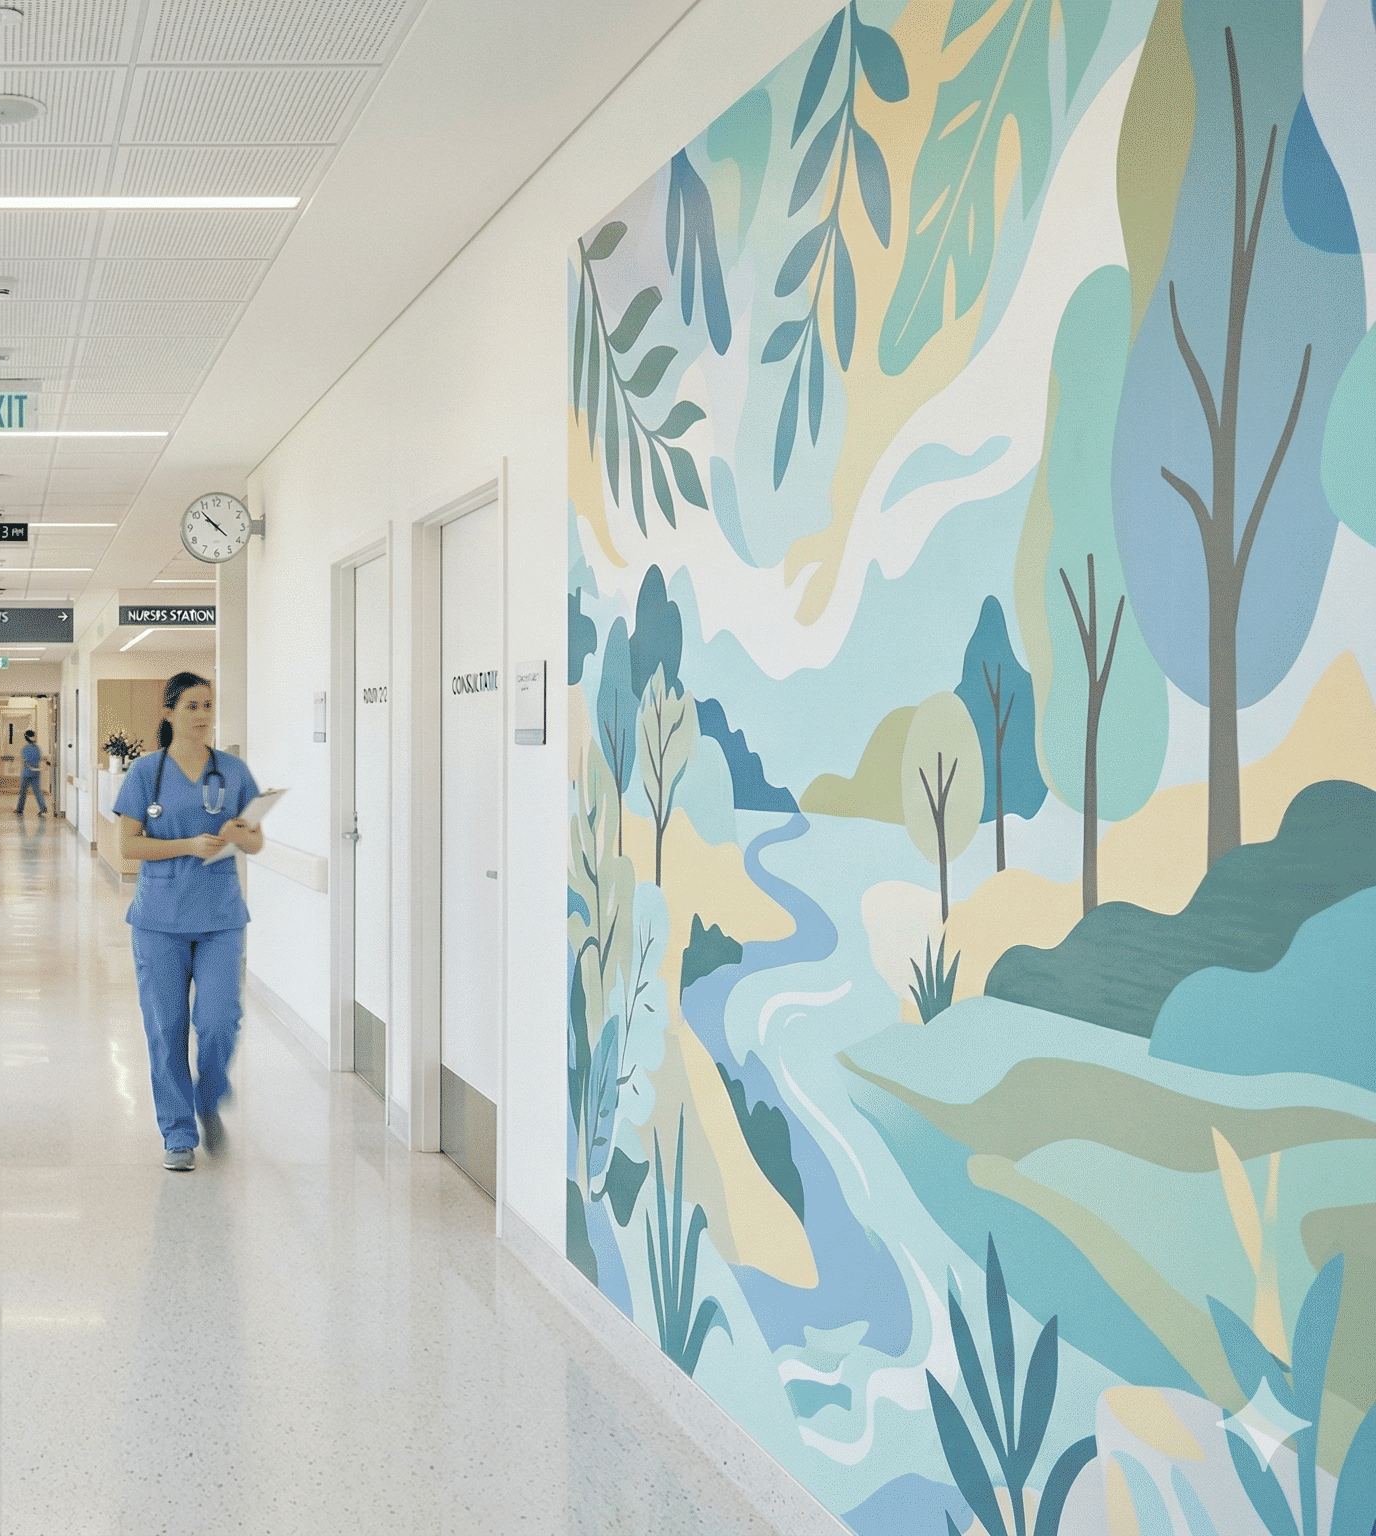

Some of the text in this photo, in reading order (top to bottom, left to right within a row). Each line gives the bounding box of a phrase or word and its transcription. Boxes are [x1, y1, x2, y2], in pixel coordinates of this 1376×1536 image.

[187, 523, 194, 532] 9
[240, 523, 246, 532] 3
[191, 536, 198, 544] 8
[235, 536, 241, 544] 4
[202, 545, 208, 554] 7
[214, 548, 220, 557] 6
